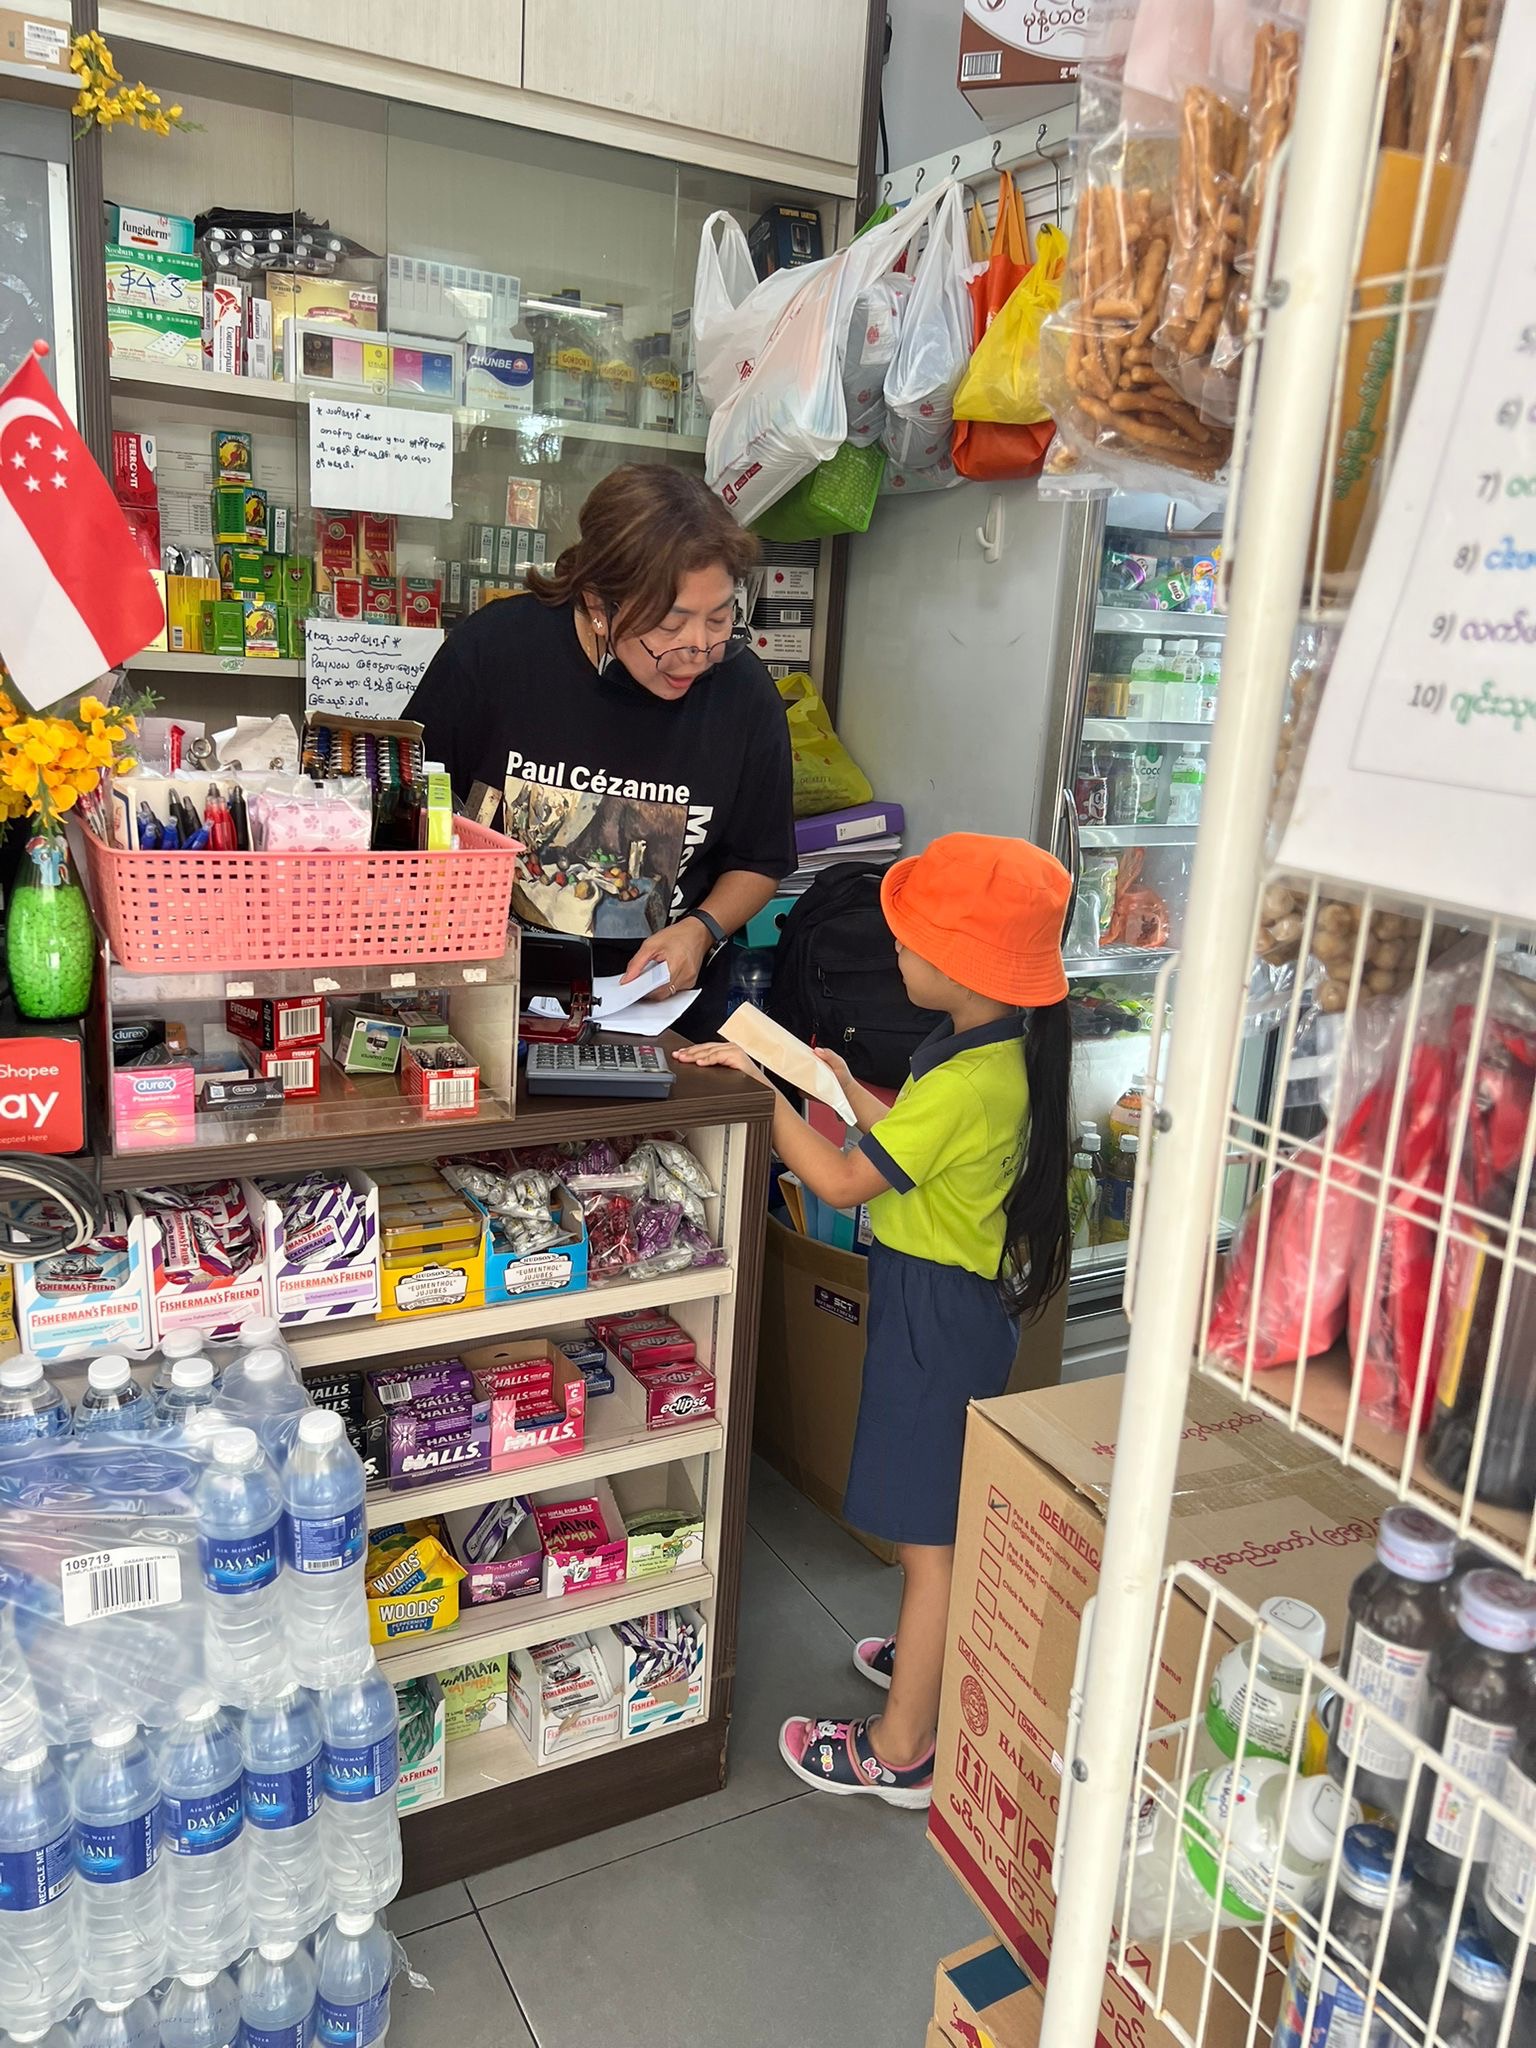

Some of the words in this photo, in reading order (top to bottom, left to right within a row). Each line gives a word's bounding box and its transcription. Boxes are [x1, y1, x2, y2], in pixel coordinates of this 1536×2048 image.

[122, 220, 169, 241] fungiderm
[224, 326, 235, 373] Counterpain
[469, 355, 513, 369] CHUNBE
[1453, 544, 1480, 575] 8)
[1168, 581, 1182, 600] MILO
[1430, 613, 1457, 645] 9)
[1408, 682, 1447, 714] 10)
[506, 750, 566, 786] Paul
[569, 766, 691, 805] Cézanne
[230, 1001, 259, 1021] EVEREADY
[113, 1028, 145, 1040] durex
[291, 1050, 316, 1058] EVEREADY
[0, 1063, 60, 1081] Shopee
[136, 1078, 174, 1092] durex
[233, 1085, 256, 1094] durex
[27, 1133, 49, 1142] Here
[307, 1224, 333, 1241] FRIEND
[516, 1264, 562, 1276] "EUMENTHOL"
[523, 1271, 553, 1281] JUJUBES
[35, 1281, 87, 1292] FISHERMAN'S
[87, 1282, 116, 1291] FRIEND
[279, 1273, 339, 1293] FISHERMAN'S
[340, 1269, 373, 1284] FRIEND
[407, 1279, 457, 1292] "EUMENTHOL"
[160, 1292, 224, 1313] FISHERMAN'S
[224, 1288, 260, 1303] FRIEND
[415, 1287, 448, 1298] JUJUBES
[31, 1306, 99, 1328] FISHERMAN'S
[100, 1302, 139, 1317] FRIEND
[571, 1389, 579, 1398] C
[660, 1396, 707, 1414] eclipse
[578, 1504, 593, 1512] SALT
[294, 1518, 302, 1537] ME
[231, 1541, 267, 1554] MINUMAN
[1010, 1519, 1035, 1550] (Original
[1034, 1544, 1053, 1567] Style)
[1012, 1508, 1025, 1523] Pea
[1029, 1522, 1046, 1543] Bean
[1045, 1537, 1071, 1571] Crunchy
[1071, 1564, 1088, 1586] Stick
[65, 1553, 111, 1571] 109719
[213, 1548, 271, 1574] DASANI
[294, 1537, 302, 1570] RECYCLE
[374, 1549, 421, 1594] WOODS'
[507, 1560, 523, 1568] Salt
[1006, 1552, 1024, 1575] (Spicy
[1023, 1568, 1037, 1589] Hot)
[1007, 1541, 1020, 1556] Pea
[1024, 1556, 1040, 1578] Bean
[1039, 1572, 1065, 1605] Crunchy
[1064, 1598, 1081, 1621] Stick
[379, 1596, 445, 1622] WOODS'
[1002, 1579, 1019, 1600] Chick
[1018, 1596, 1030, 1612] Pea
[1029, 1607, 1045, 1629] Stick
[391, 1618, 429, 1629] PEPPERMINT
[1013, 1626, 1031, 1650] Kyaw
[993, 1642, 1011, 1667] Prawn
[1010, 1661, 1034, 1691] Cracker
[1032, 1686, 1048, 1707] Stick
[542, 1683, 575, 1701] FISHERMAN'S
[574, 1678, 596, 1692] FRIEND
[560, 1693, 582, 1703] ORIGINAL
[591, 1710, 619, 1726] FRIEND
[1019, 1715, 1038, 1743] Date
[305, 1763, 312, 1778] ME
[409, 1766, 439, 1782] FRIEND
[997, 1730, 1047, 1801] HALAL
[252, 1790, 277, 1805] ANI
[305, 1778, 313, 1816] RECYCLE
[144, 1814, 151, 1827] ME
[187, 1799, 240, 1832] DASANI
[35, 1849, 45, 1863] ME
[145, 1826, 153, 1869] RECYCLE
[36, 1863, 47, 1905] RECYCLE
